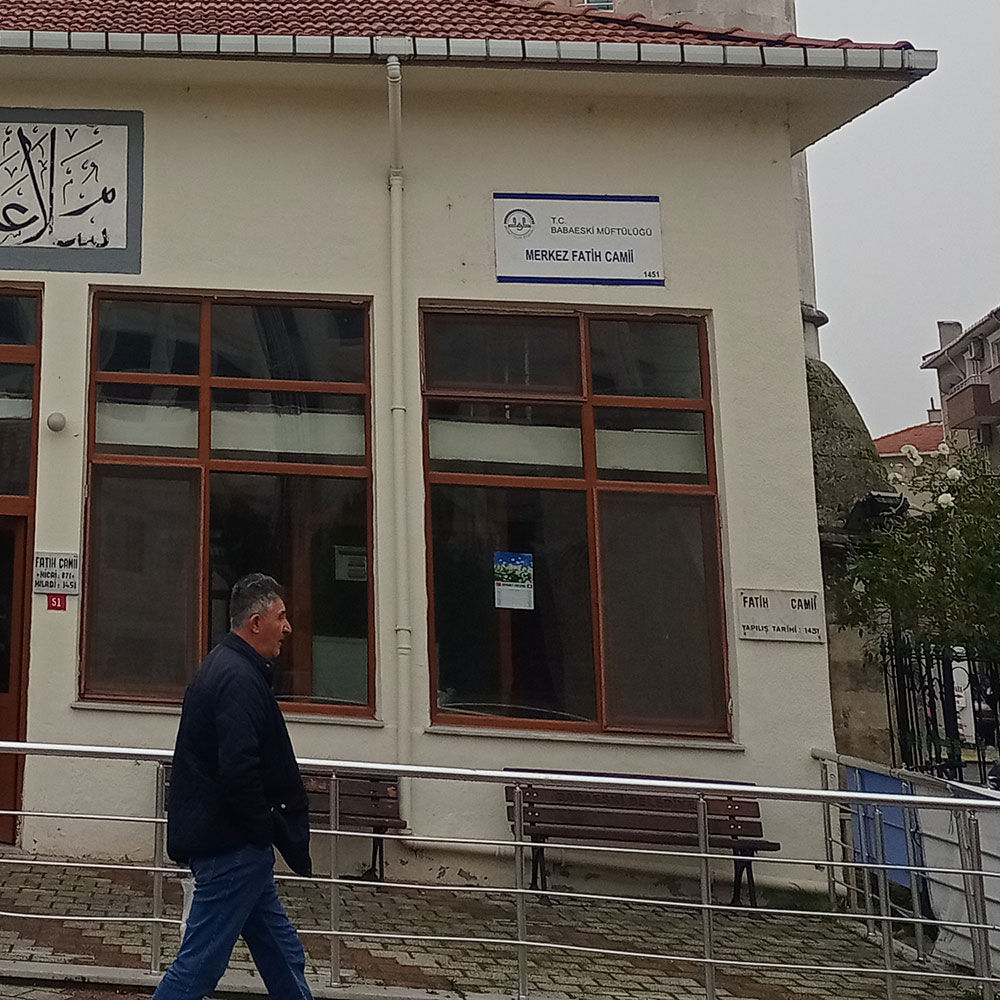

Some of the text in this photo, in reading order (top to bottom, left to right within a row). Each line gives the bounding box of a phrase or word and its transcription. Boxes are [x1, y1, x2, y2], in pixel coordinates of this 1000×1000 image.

[550, 225, 653, 237] BABAESKİ MÜFTÜLÜĞÜ
[525, 247, 634, 263] MERKEZ FATİH CAMİİ
[51, 598, 61, 607] 51
